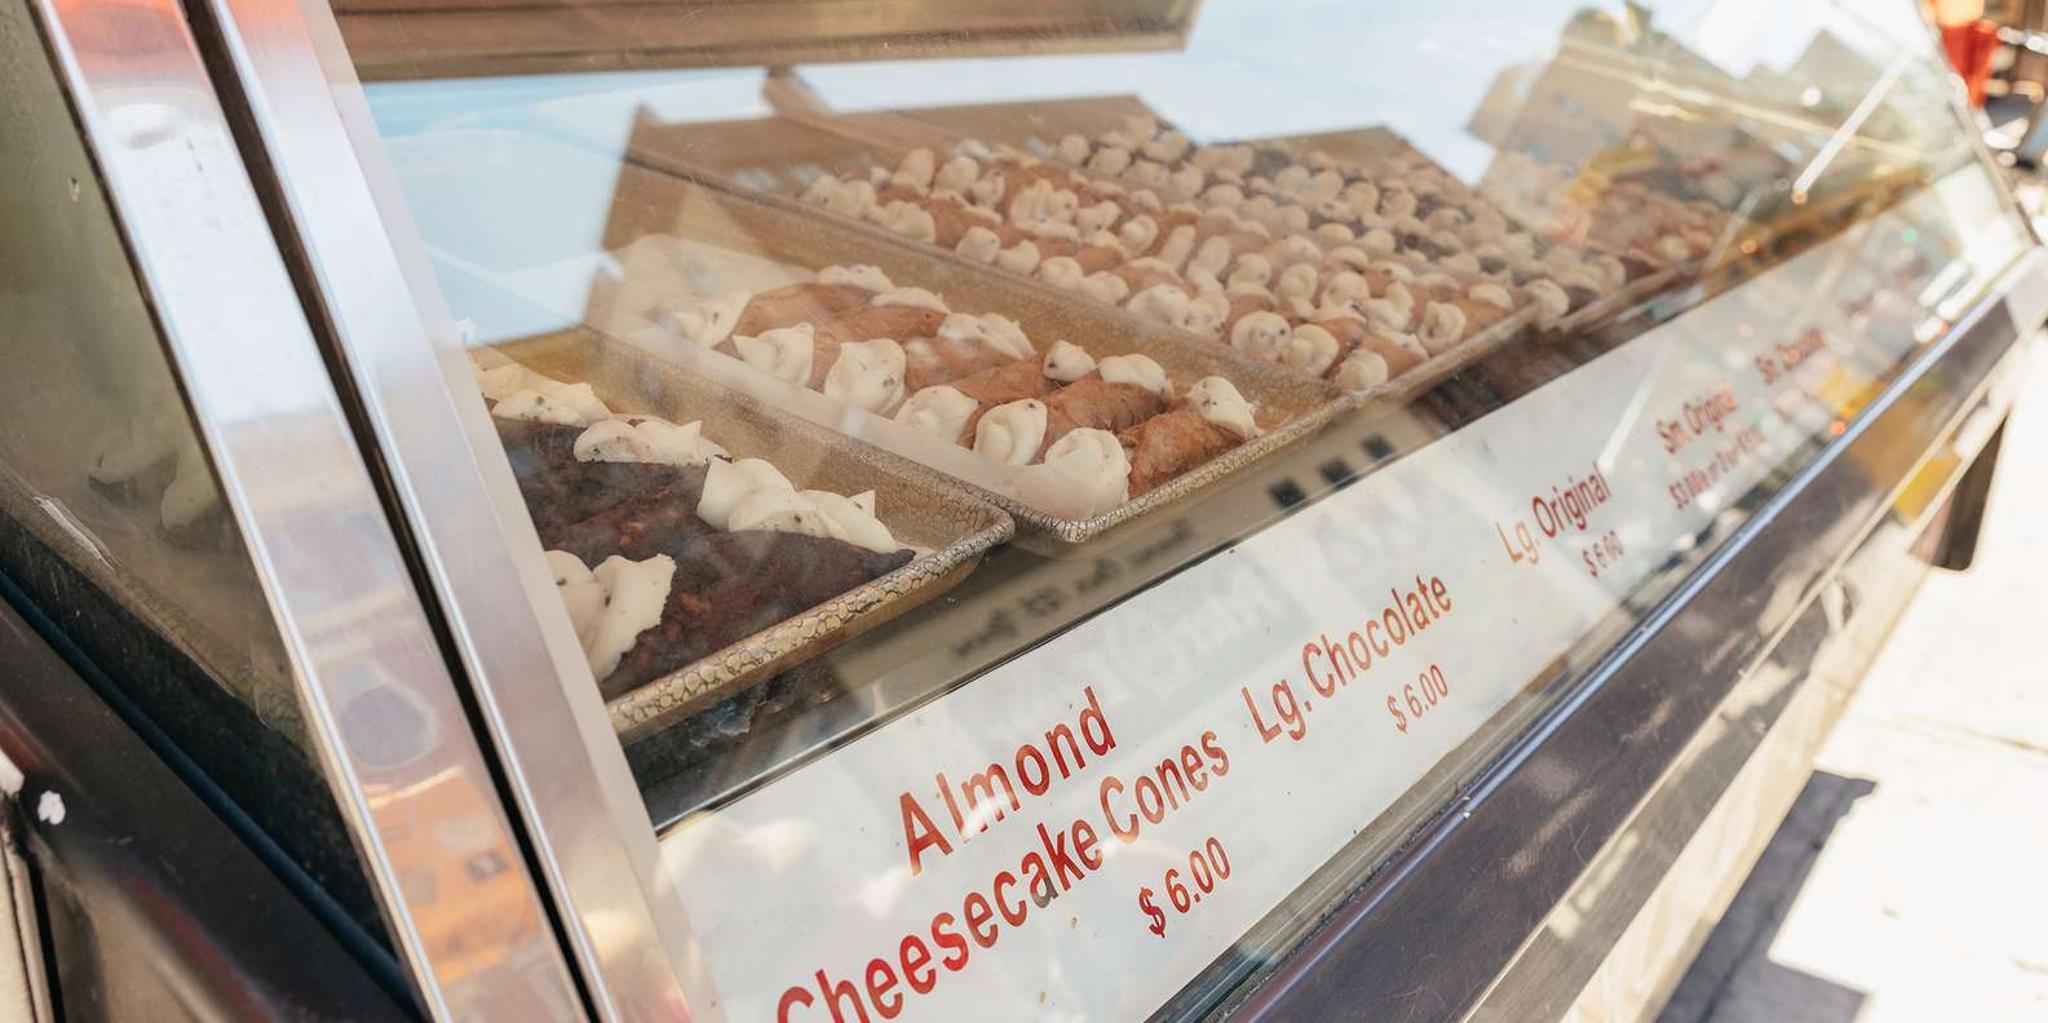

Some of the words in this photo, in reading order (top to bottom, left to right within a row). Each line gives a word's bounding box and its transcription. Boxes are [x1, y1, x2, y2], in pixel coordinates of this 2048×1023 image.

[1532, 458, 1612, 538] Original
[1241, 679, 1312, 744] Lg.
[1302, 574, 1451, 698] Chocolate
[899, 685, 1117, 876] Almond
[1099, 730, 1230, 845] Cones
